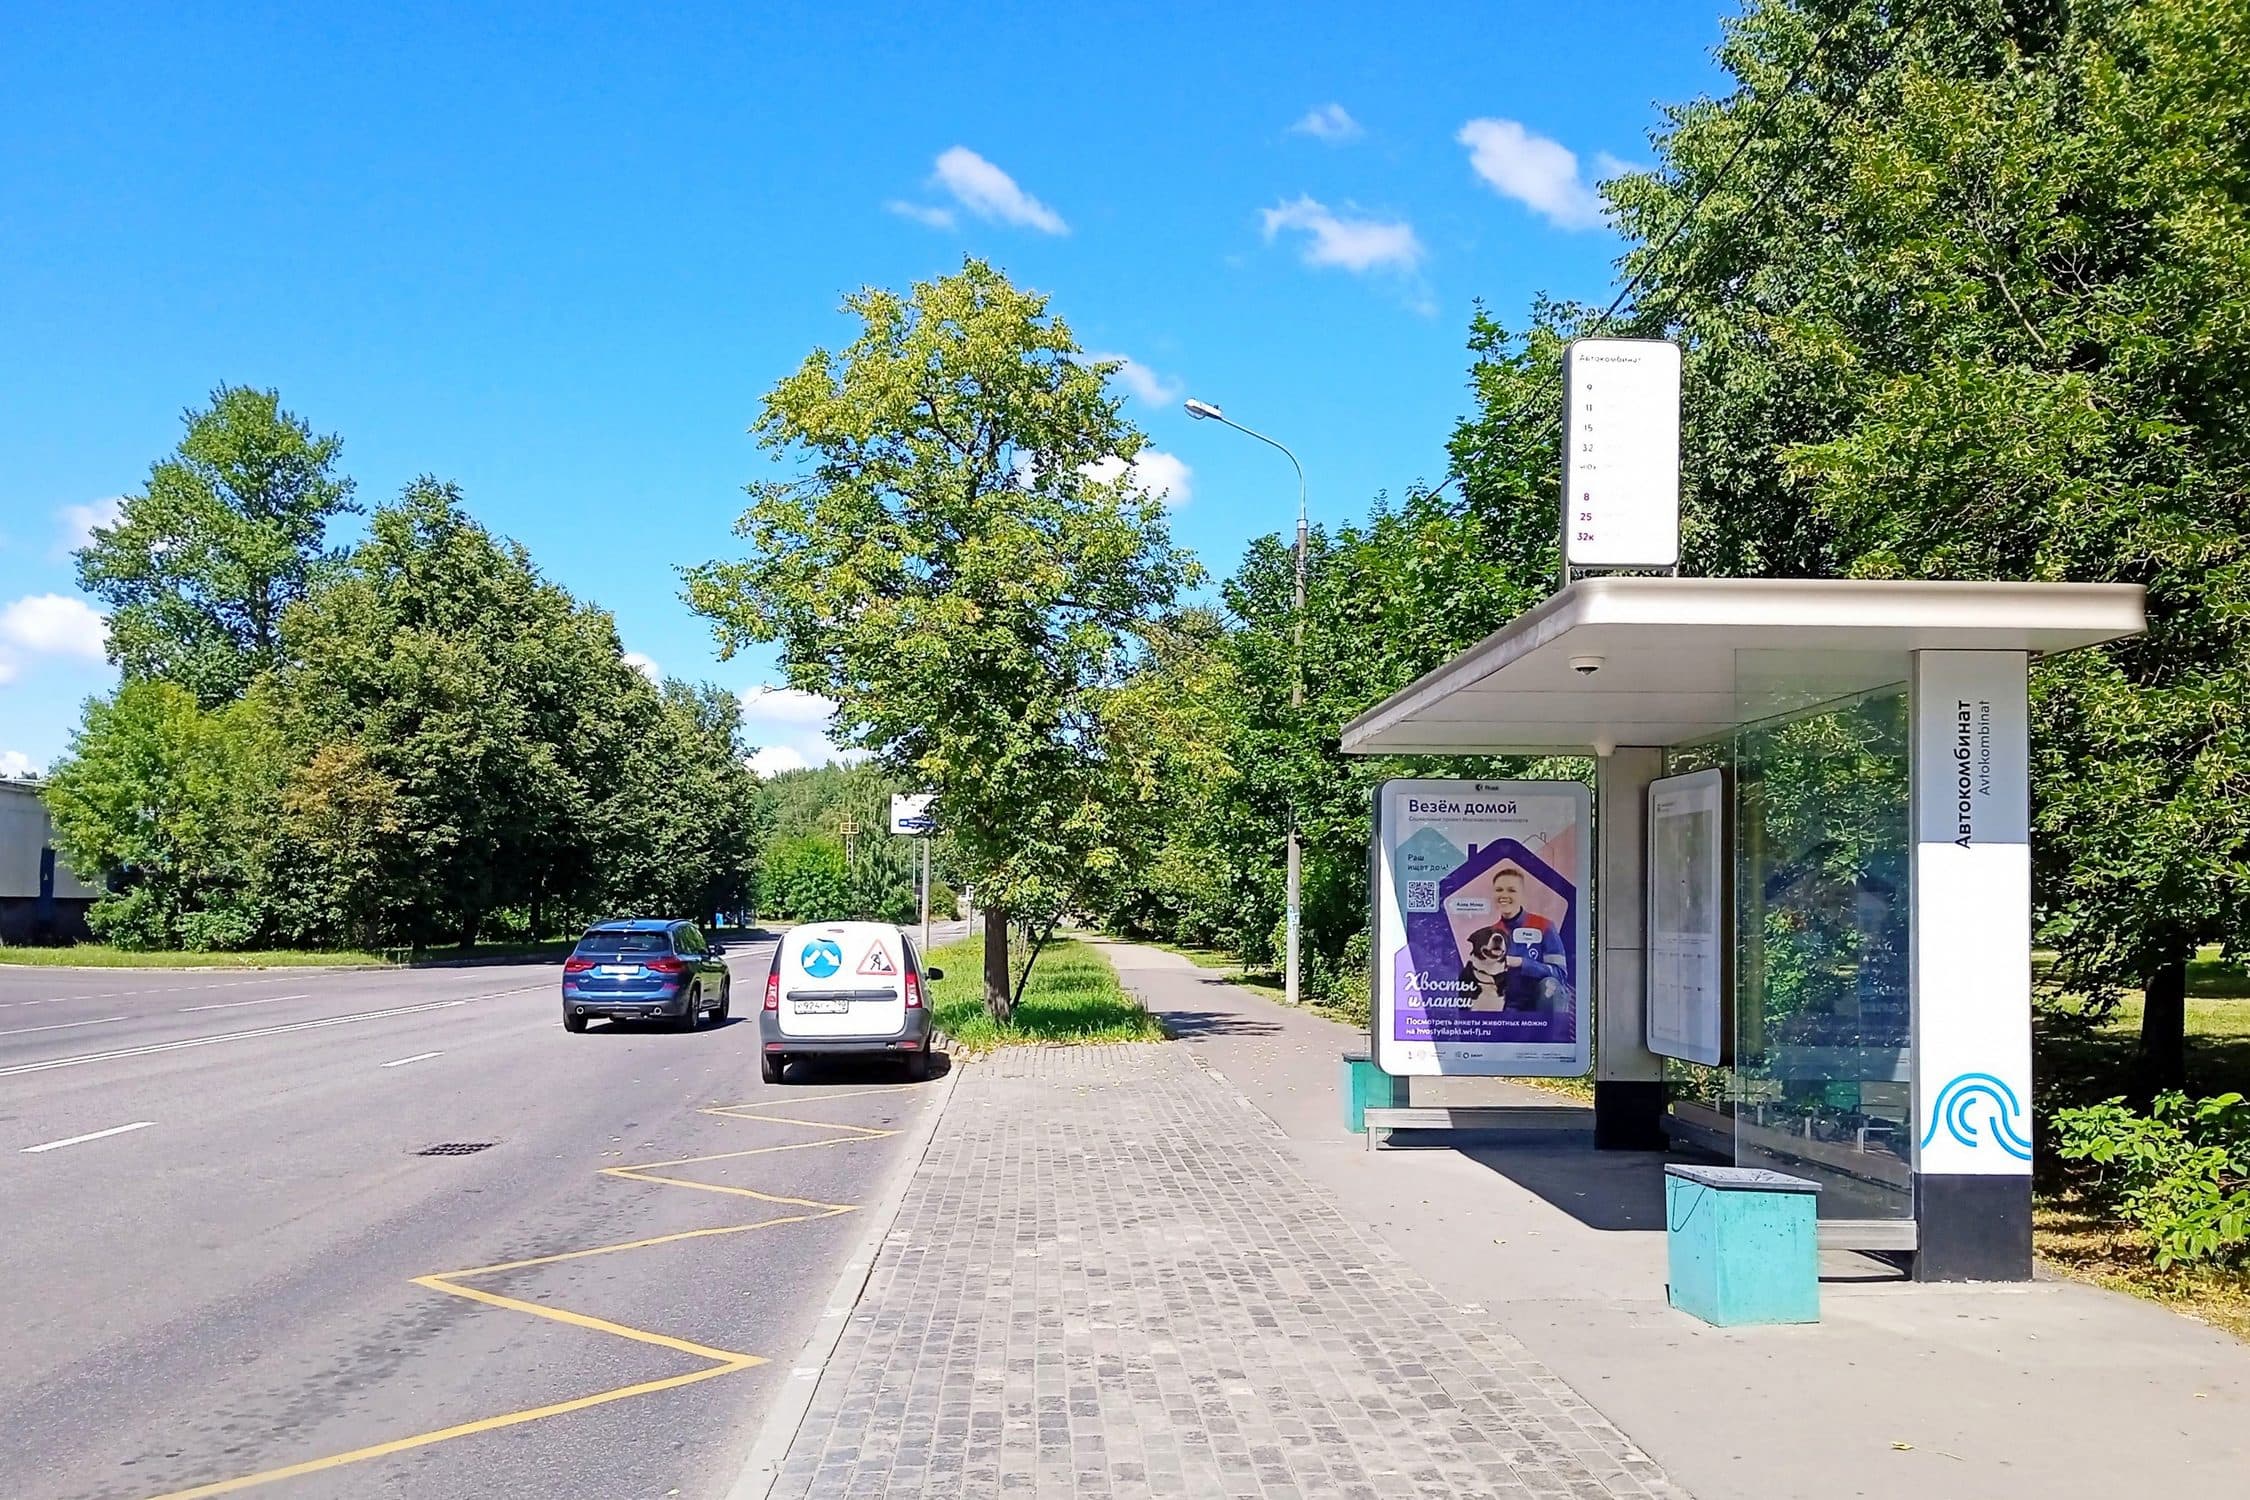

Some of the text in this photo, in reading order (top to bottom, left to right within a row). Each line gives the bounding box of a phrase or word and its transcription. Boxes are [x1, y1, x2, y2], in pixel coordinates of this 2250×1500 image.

[1584, 424, 1593, 432] 15
[1582, 443, 1594, 452] 32
[1583, 493, 1590, 501] 8
[1580, 512, 1592, 521] 25
[1577, 532, 1594, 541] 32к
[1978, 700, 1991, 796] Avtokombinat
[1953, 700, 1972, 849] Автокомбинат
[1409, 799, 1517, 815] Везём домой
[1404, 971, 1477, 992] Хвосты
[1408, 996, 1474, 1009] и лапки
[1405, 1018, 1453, 1027] Посмотреть
[1453, 1019, 1481, 1027] анкеты
[1481, 1019, 1520, 1027] животных
